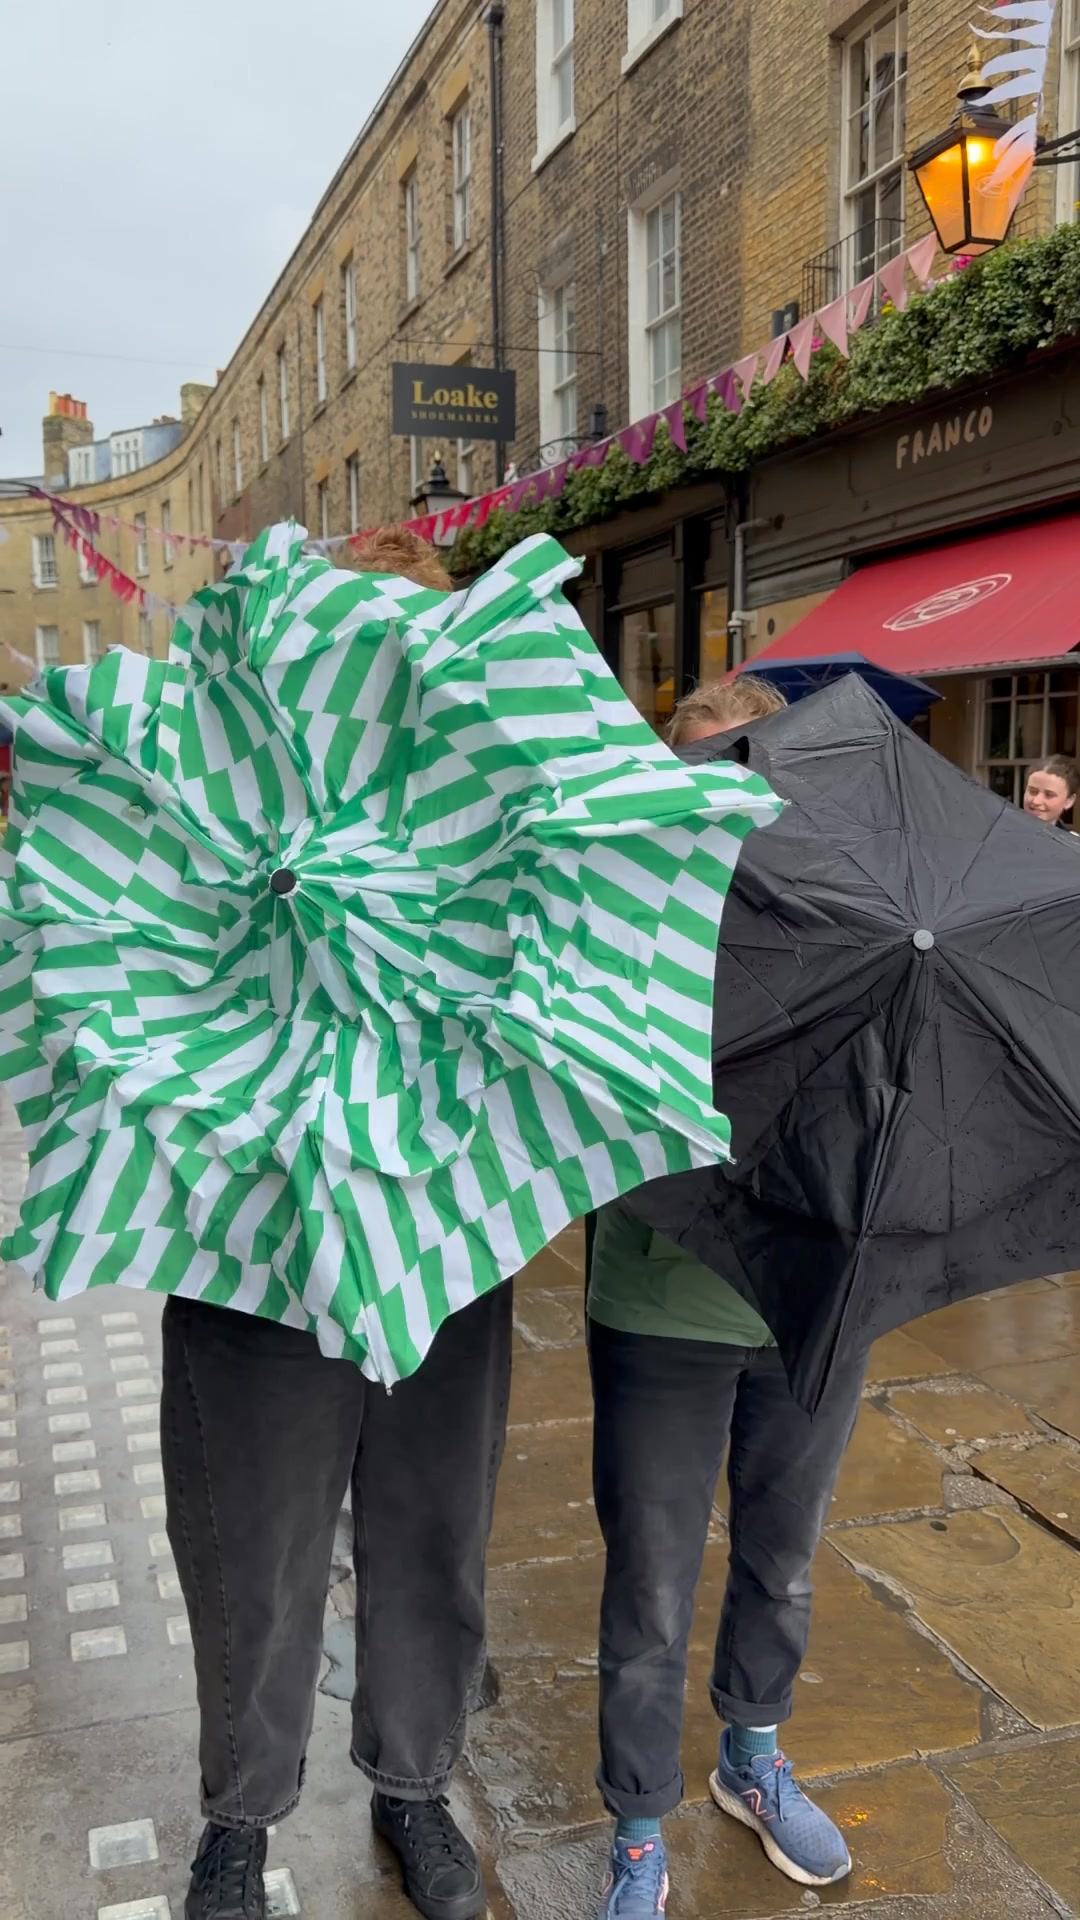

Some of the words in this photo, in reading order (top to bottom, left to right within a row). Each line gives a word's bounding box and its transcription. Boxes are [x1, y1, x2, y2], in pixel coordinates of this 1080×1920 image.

[412, 380, 499, 409] Loake
[410, 410, 499, 424] SHOEMAKERS
[896, 406, 993, 469] FRANCO
